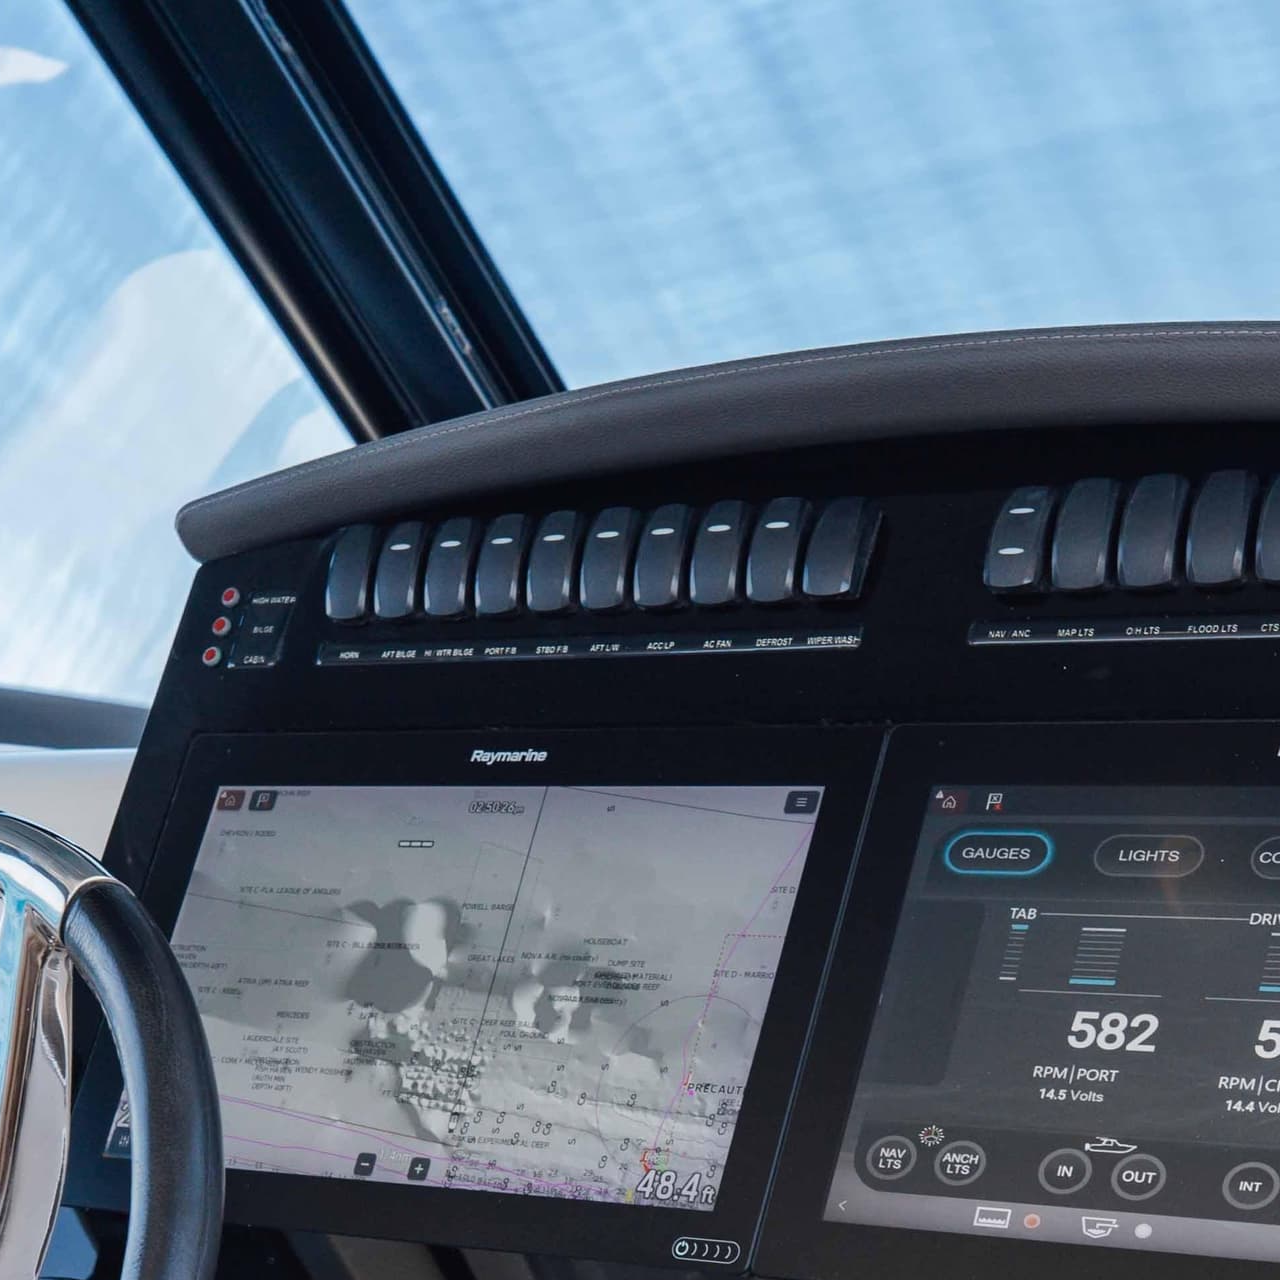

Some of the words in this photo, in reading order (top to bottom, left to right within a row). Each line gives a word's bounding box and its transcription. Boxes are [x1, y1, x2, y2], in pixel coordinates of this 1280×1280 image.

[253, 625, 275, 634] BILGE
[988, 628, 1007, 638] NAV
[1011, 628, 1031, 638] ANC
[1056, 628, 1077, 638] MAP
[1077, 627, 1096, 637] LTS
[1143, 625, 1161, 635] LTS
[1187, 624, 1221, 634] FLOOD
[1221, 623, 1239, 633] LTS
[646, 642, 664, 651] ACC
[664, 641, 675, 650] LP
[703, 640, 714, 649] AC
[715, 639, 733, 648] FAN
[755, 637, 793, 647] DEFROST
[806, 635, 833, 645] WIPER
[380, 650, 394, 659] AFT
[395, 650, 417, 659] BILGE
[452, 648, 475, 657] BILGE
[484, 647, 504, 656] PORT
[589, 644, 605, 653] AFT
[339, 651, 360, 660] HORN
[470, 749, 548, 765] Raymarine
[961, 846, 1031, 861] GAUGES
[1117, 849, 1181, 863] LIGHTS
[1010, 907, 1038, 920] TAB
[1067, 1010, 1160, 1054] 582
[686, 1082, 744, 1096] PRECAUT
[1039, 1088, 1068, 1102] 14.5
[1071, 1089, 1105, 1103] Volts
[1225, 1099, 1256, 1113] 14.4
[879, 1147, 907, 1159] NAV
[942, 1152, 980, 1165] ANCH
[878, 1158, 902, 1170] LTS
[946, 1164, 971, 1176] LTS
[1056, 1165, 1075, 1179] IN
[1121, 1170, 1157, 1185] OUT
[636, 1168, 702, 1202] 48.4
[699, 1184, 716, 1205] ft
[1238, 1181, 1263, 1194] INT
